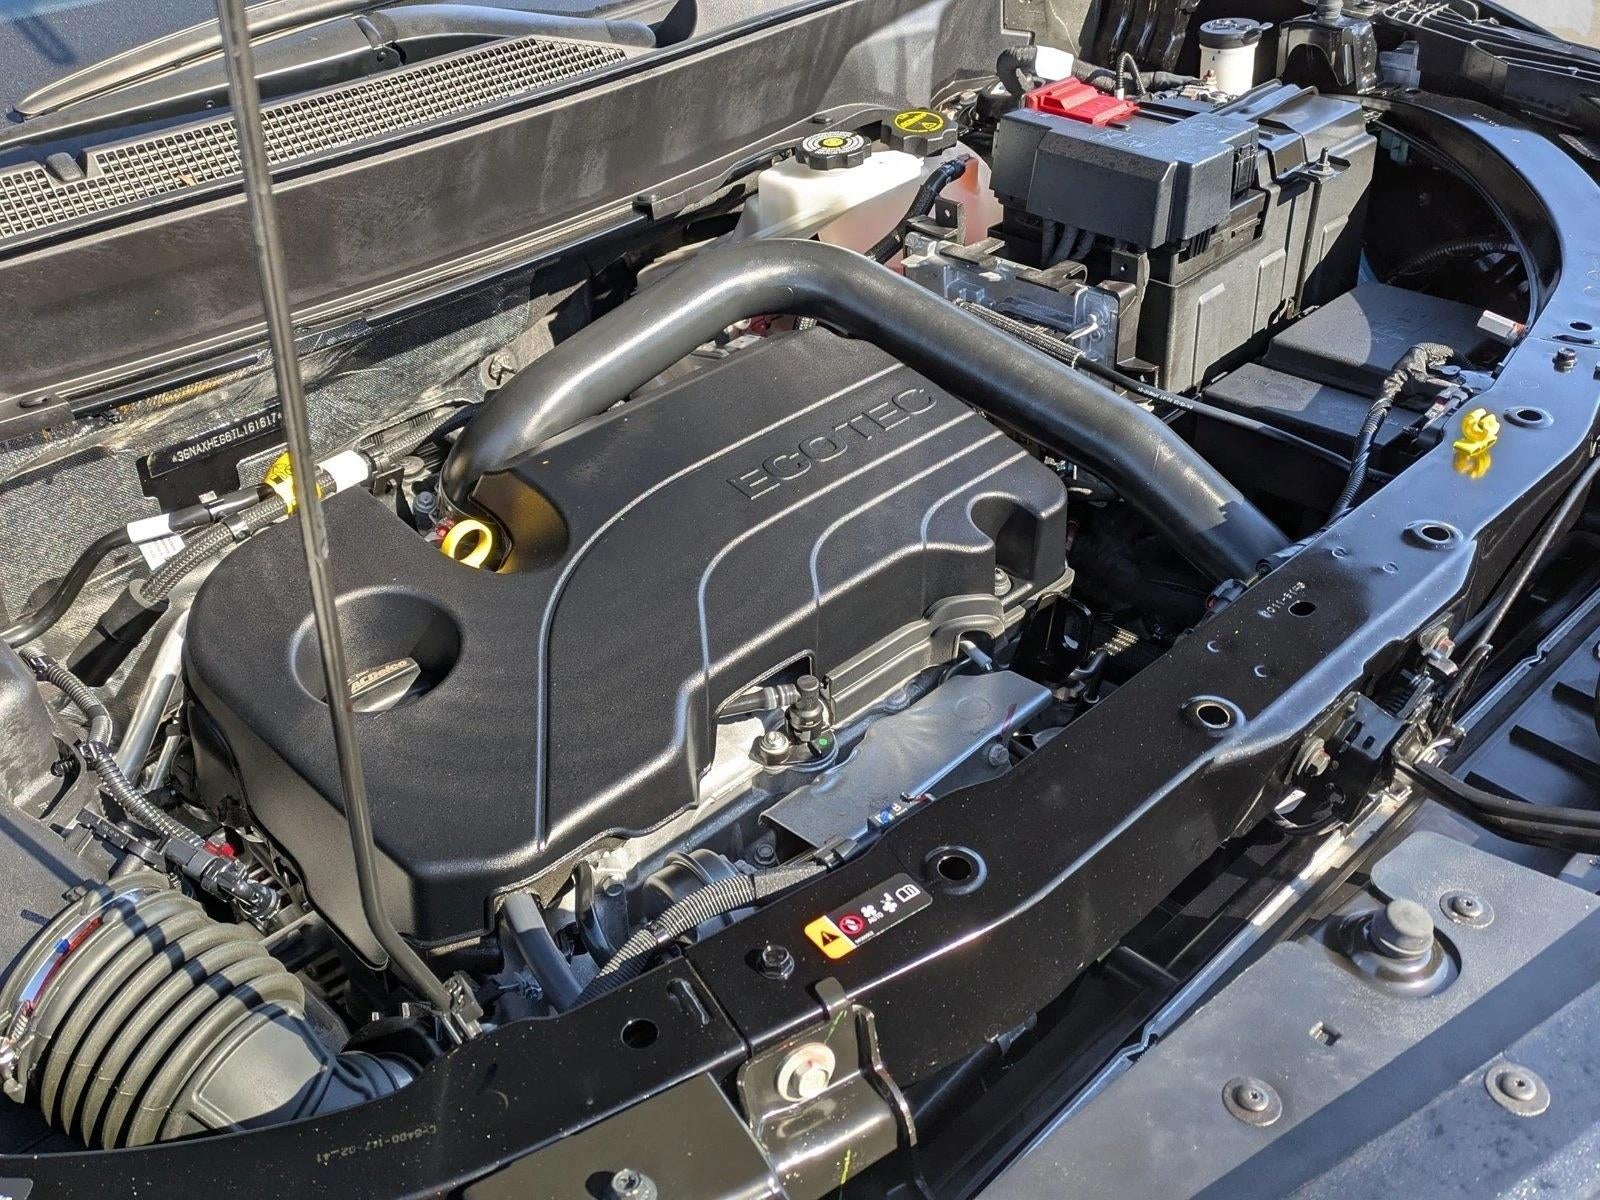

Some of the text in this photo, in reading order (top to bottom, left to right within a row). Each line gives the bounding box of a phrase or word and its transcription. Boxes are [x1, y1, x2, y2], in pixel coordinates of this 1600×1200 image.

[726, 389, 937, 500] ECOTEC
[350, 660, 408, 693] ACDelco
[868, 911, 885, 925] AUTO
